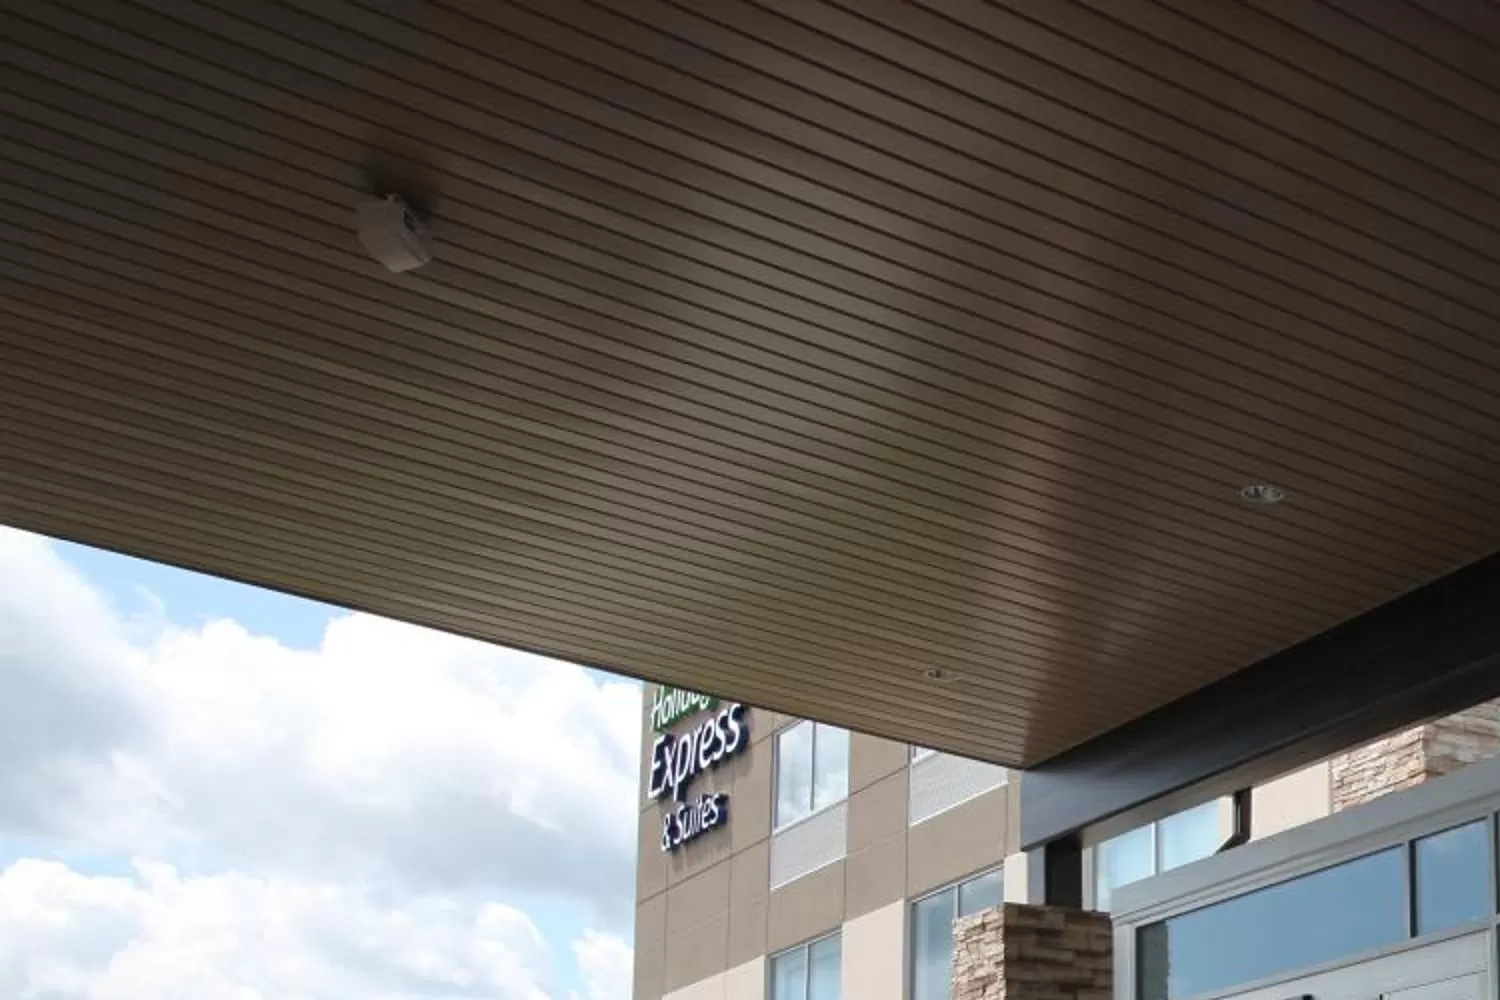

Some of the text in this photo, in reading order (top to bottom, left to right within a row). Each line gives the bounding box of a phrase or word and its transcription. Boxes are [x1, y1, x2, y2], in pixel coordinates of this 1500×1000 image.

[648, 703, 742, 802] Express
[660, 793, 720, 852] & Suites
